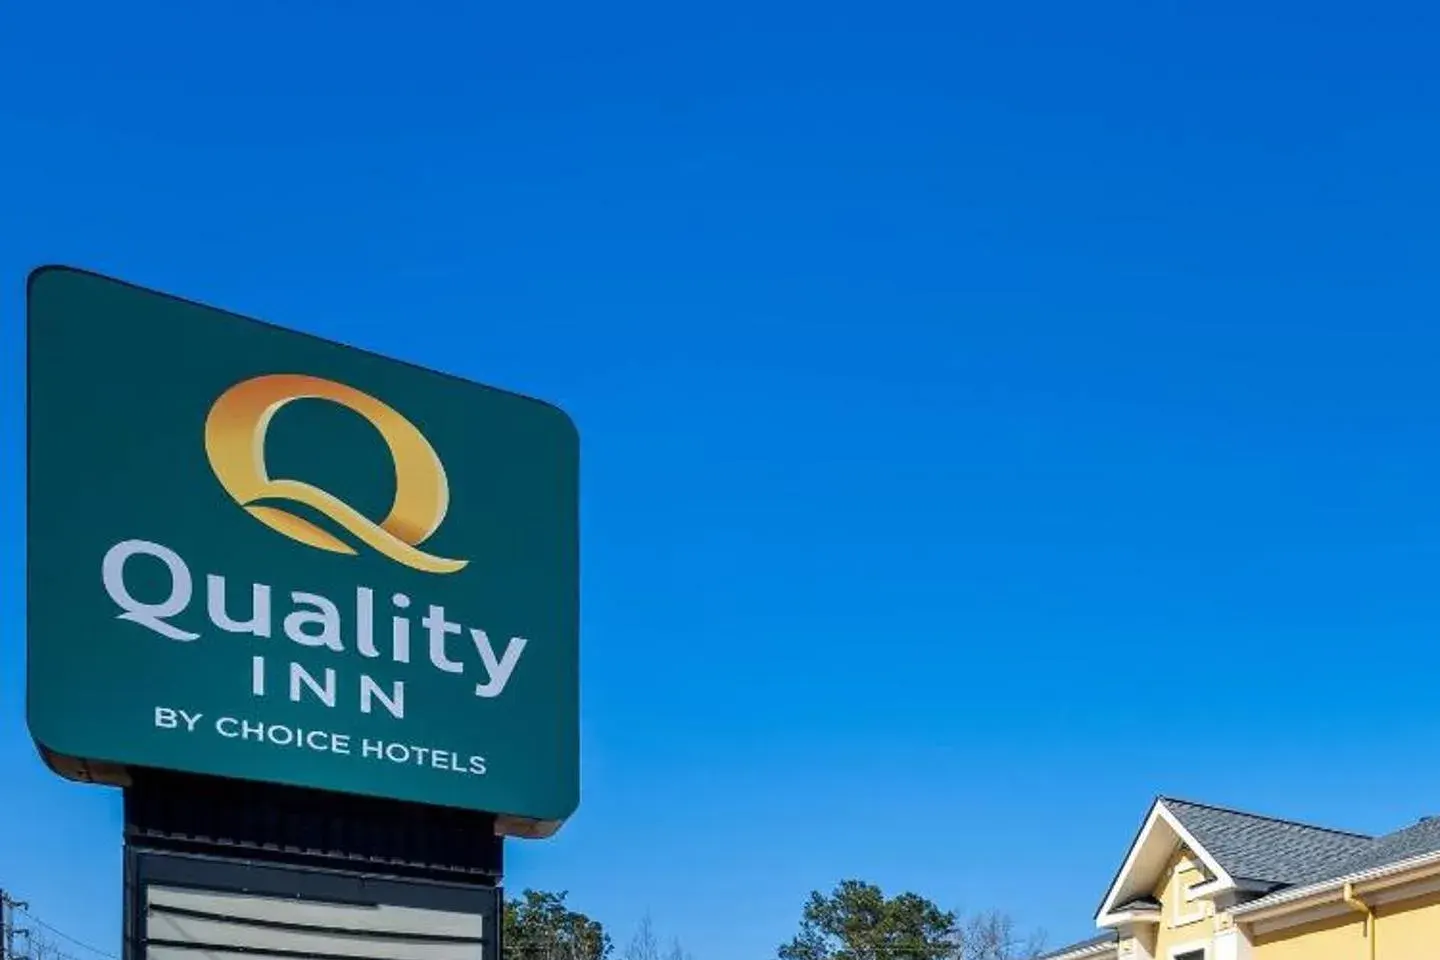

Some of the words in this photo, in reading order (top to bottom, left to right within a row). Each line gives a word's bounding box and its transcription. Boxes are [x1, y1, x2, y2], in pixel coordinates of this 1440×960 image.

[101, 538, 528, 698] Quality
[252, 655, 405, 719] INN
[154, 706, 203, 733] BY
[215, 716, 350, 755] CHOICE
[361, 738, 487, 776] HOTELS
